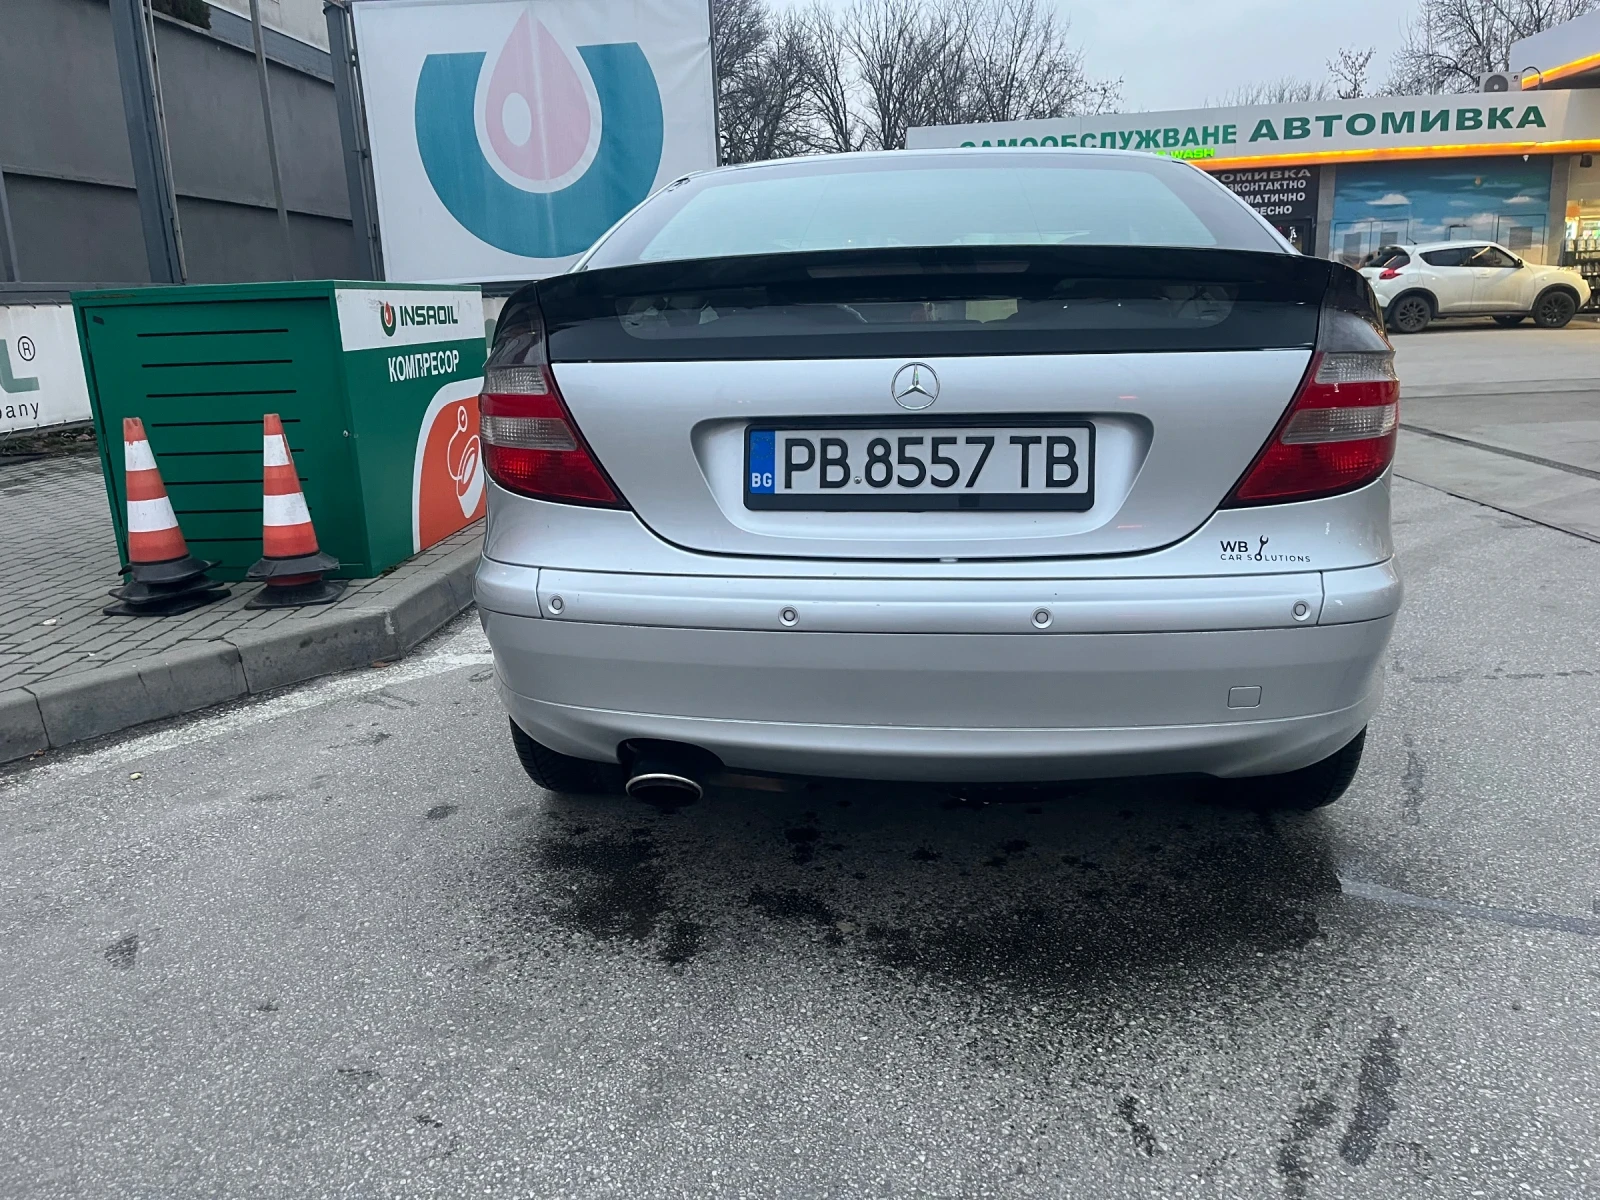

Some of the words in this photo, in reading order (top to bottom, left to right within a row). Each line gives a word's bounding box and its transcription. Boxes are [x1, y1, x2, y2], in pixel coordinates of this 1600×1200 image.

[1248, 105, 1547, 143] АВТОМИВКА
[1170, 148, 1215, 159] WASH
[1225, 179, 1307, 192] ЗКОНТАКТНО
[399, 305, 459, 327] INSAOIL
[387, 349, 460, 383] КОМПРЕСОР
[0, 402, 39, 420] any
[784, 437, 851, 489] PB
[864, 436, 996, 488] 8557
[1009, 435, 1079, 488] TB
[751, 472, 773, 488] BG
[1220, 540, 1249, 553] WB
[1220, 553, 1243, 561] CAR
